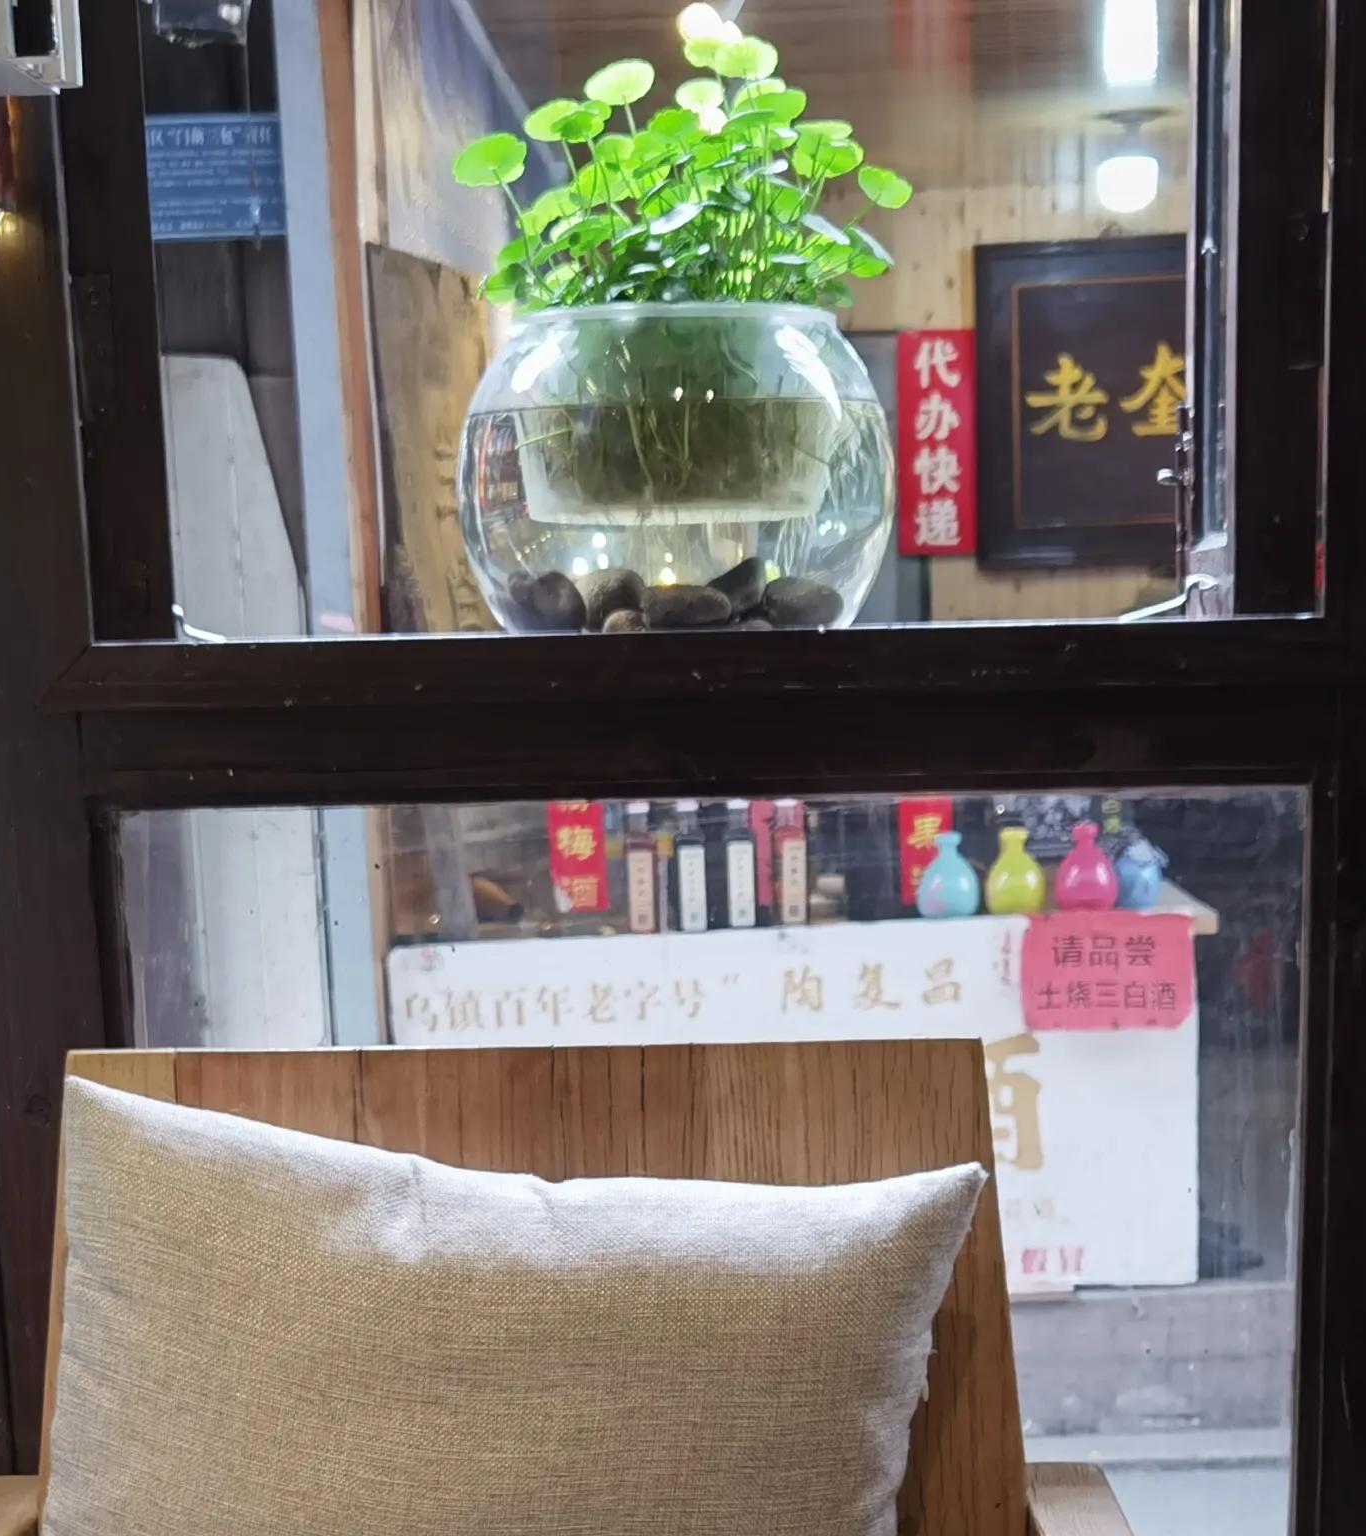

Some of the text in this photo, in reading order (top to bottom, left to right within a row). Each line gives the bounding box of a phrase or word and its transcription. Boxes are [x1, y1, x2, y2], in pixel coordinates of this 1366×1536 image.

[913, 339, 962, 547] 代办快递
[555, 800, 599, 907] 梅酒
[1052, 935, 1155, 971] 请品尝
[1036, 980, 1177, 1011] 土烧三白酒
